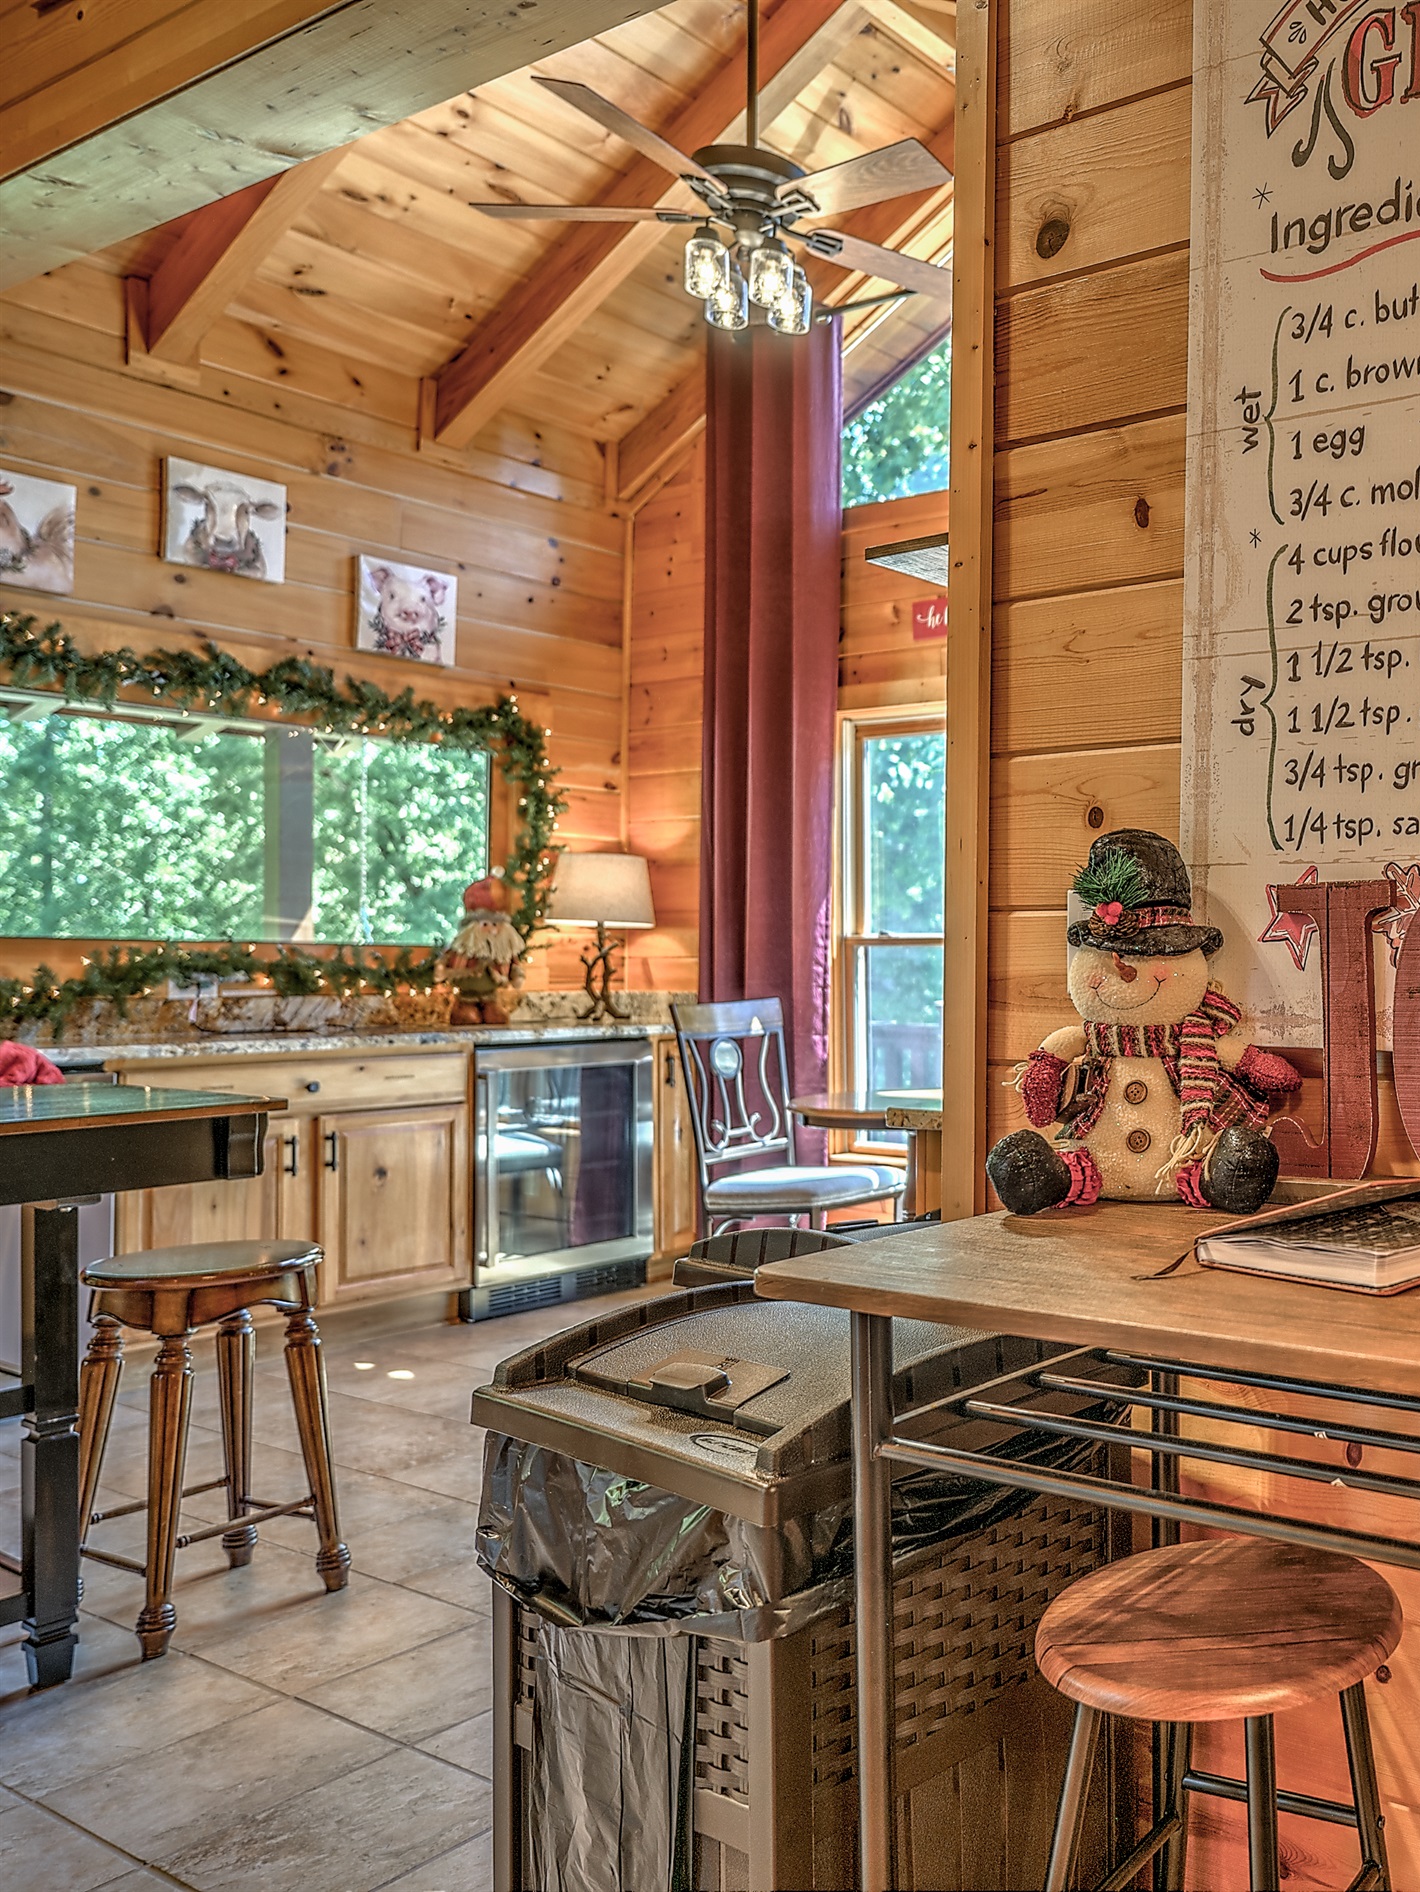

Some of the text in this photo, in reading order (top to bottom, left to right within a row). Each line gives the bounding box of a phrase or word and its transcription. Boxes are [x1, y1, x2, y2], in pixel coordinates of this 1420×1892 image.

[1291, 302, 1333, 344] 3/4
[1344, 308, 1365, 329] c.
[1288, 368, 1305, 403] 1
[1315, 372, 1335, 394] c.
[1233, 385, 1262, 455] wet
[1290, 424, 1366, 461] 1 egg
[1289, 479, 1333, 522] 3/4
[1339, 485, 1361, 508] c.
[1287, 543, 1306, 576] 4
[1313, 541, 1373, 576] cups
[1285, 598, 1303, 625] 2
[1308, 592, 1358, 630] tsp.
[1286, 651, 1302, 683] 1
[1310, 640, 1354, 679] 1/2
[1360, 640, 1410, 679] tsp.
[1230, 674, 1266, 737] dry
[1287, 705, 1302, 734] 1
[1311, 695, 1356, 735] 1/2
[1358, 696, 1411, 736] tsp.
[1284, 749, 1326, 792] 3/4
[1332, 753, 1383, 794] tsp.
[1283, 806, 1328, 852] 1/4
[1332, 812, 1381, 847] tsp.
